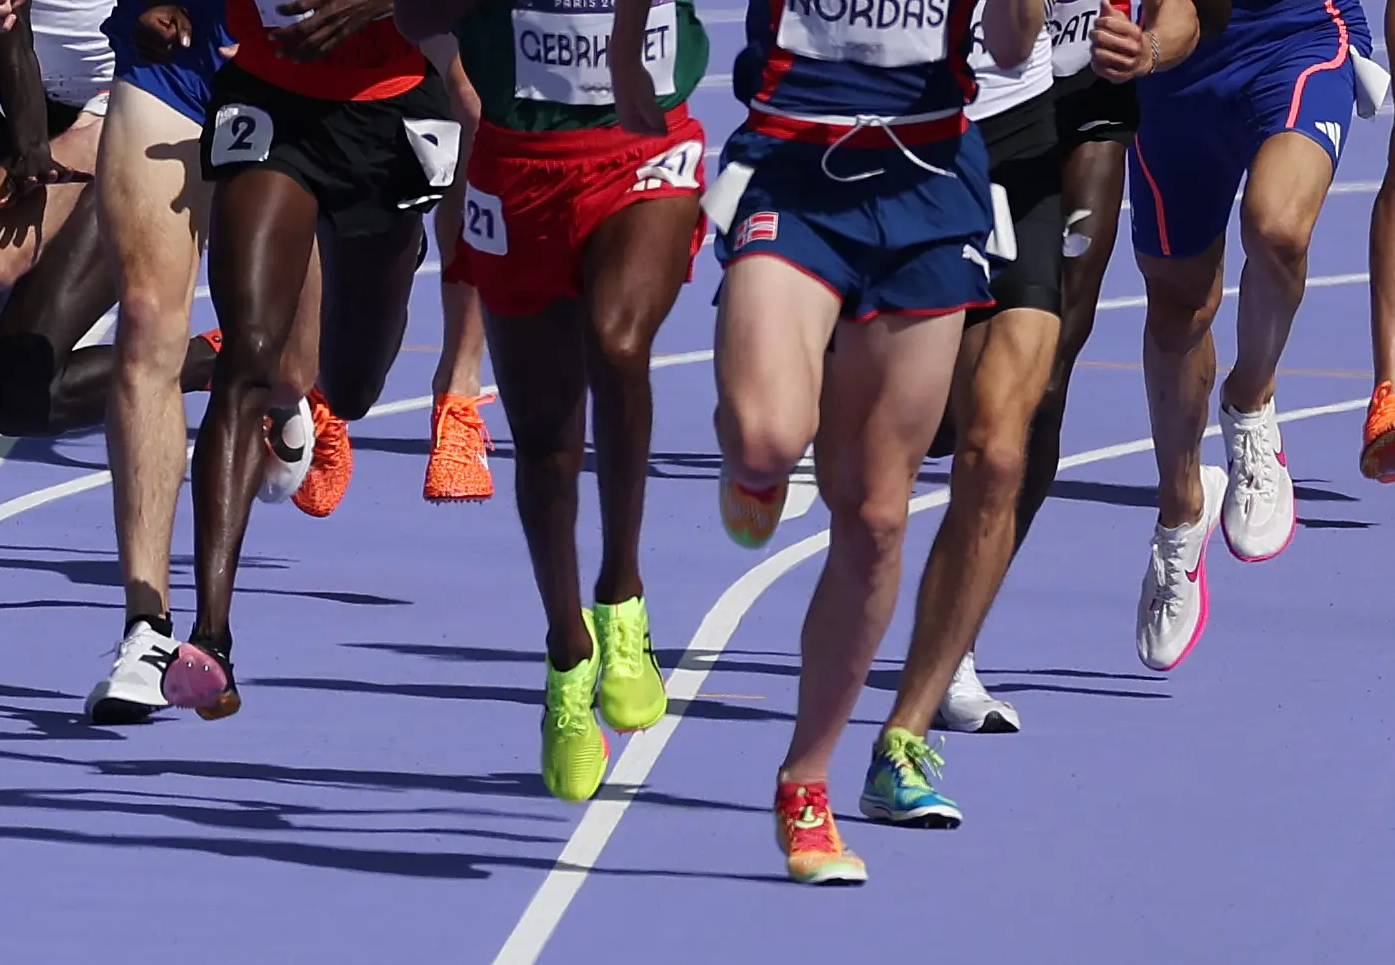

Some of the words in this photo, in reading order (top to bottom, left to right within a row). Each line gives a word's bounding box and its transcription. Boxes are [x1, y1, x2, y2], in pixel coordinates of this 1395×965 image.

[520, 25, 670, 68] GEBRHET
[227, 115, 256, 152] 2
[467, 199, 494, 240] 21
